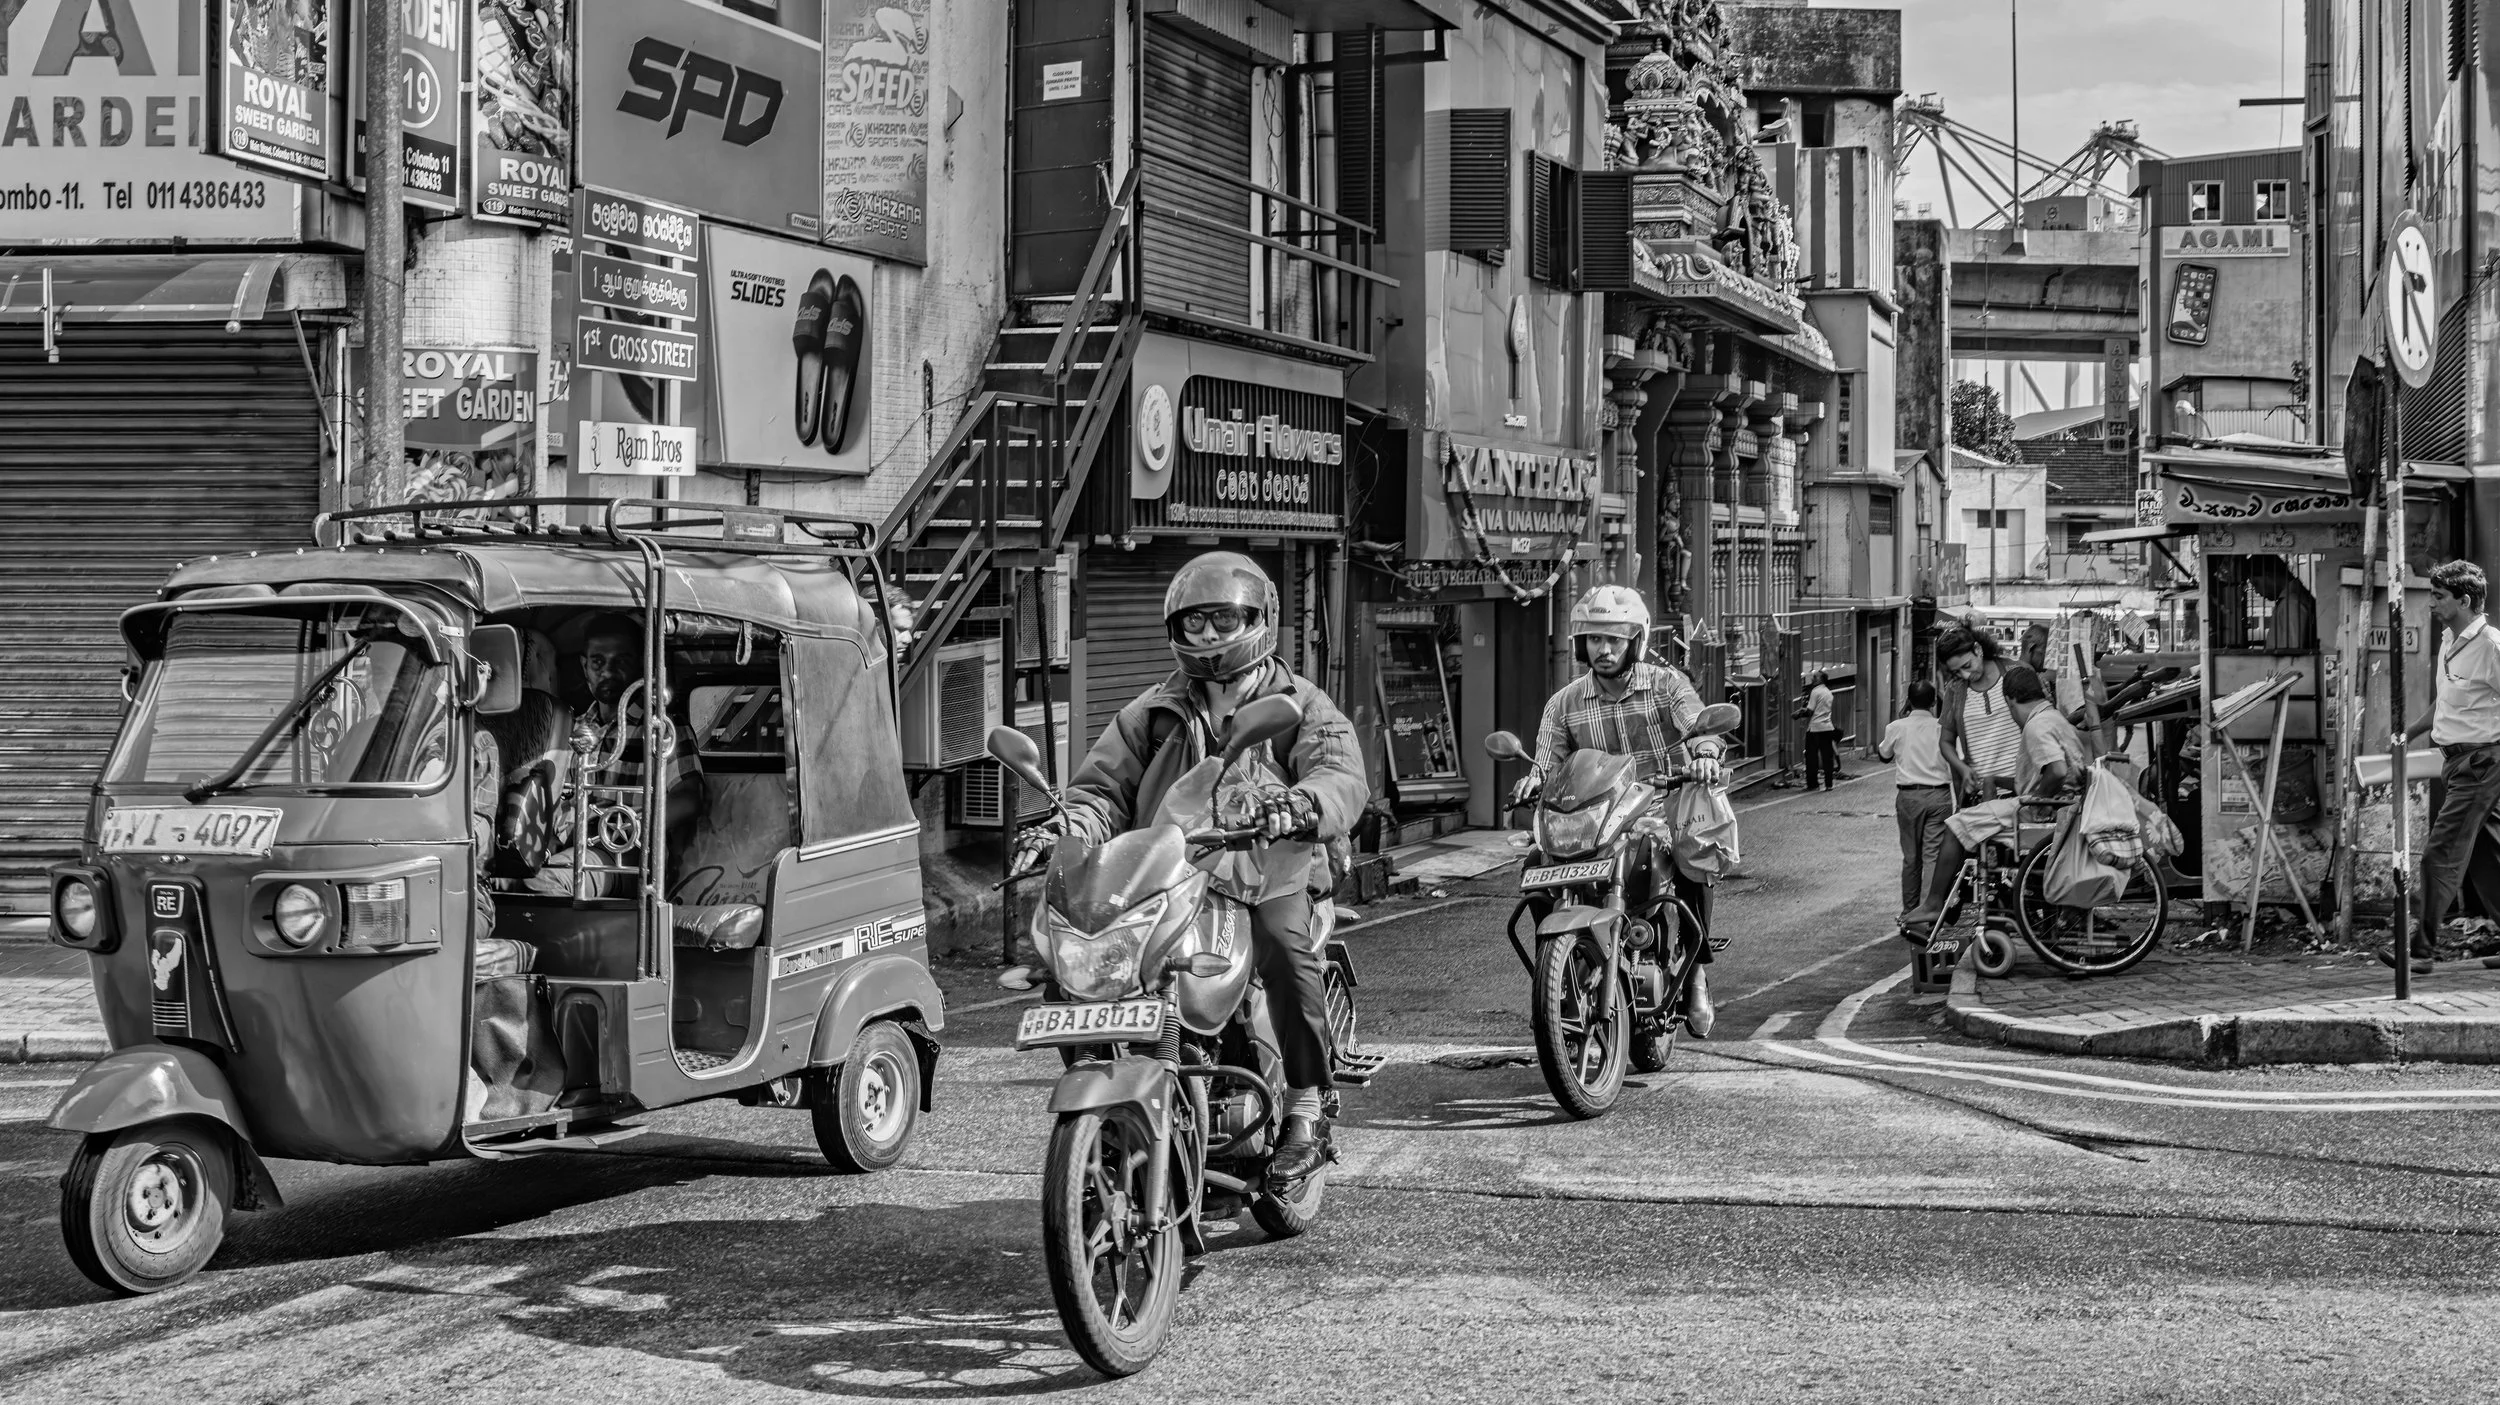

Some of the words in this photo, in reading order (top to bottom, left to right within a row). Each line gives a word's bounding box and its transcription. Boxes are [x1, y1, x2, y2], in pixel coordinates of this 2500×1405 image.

[244, 71, 313, 121] ROYAL
[616, 36, 784, 147] SPD
[842, 62, 915, 110] SPEED
[2, 96, 200, 147] ARDE
[235, 104, 275, 132] SWEET
[276, 117, 320, 146] GARDEN
[406, 146, 440, 168] Colombo
[410, 168, 442, 191] 4386433
[488, 182, 538, 200] SWEET
[500, 158, 567, 192] ROYAL
[104, 181, 132, 209] Tel
[865, 193, 922, 225] KHAZANA
[864, 215, 908, 241] SPORTS
[2180, 228, 2275, 248] AGAMI
[593, 266, 598, 288] 1
[730, 280, 786, 308] SLIDES
[583, 327, 601, 355] 1st
[609, 334, 648, 363] CROSS
[650, 339, 694, 368] STREET
[456, 386, 534, 423] GARDEN
[616, 427, 649, 468] Ram
[652, 430, 682, 463] Bros
[1183, 405, 1255, 457] Umair
[1255, 414, 1343, 466] Flowers
[1461, 508, 1503, 530] SIVA
[194, 813, 273, 849] 4097
[157, 895, 177, 911] RE
[853, 918, 894, 956] RE
